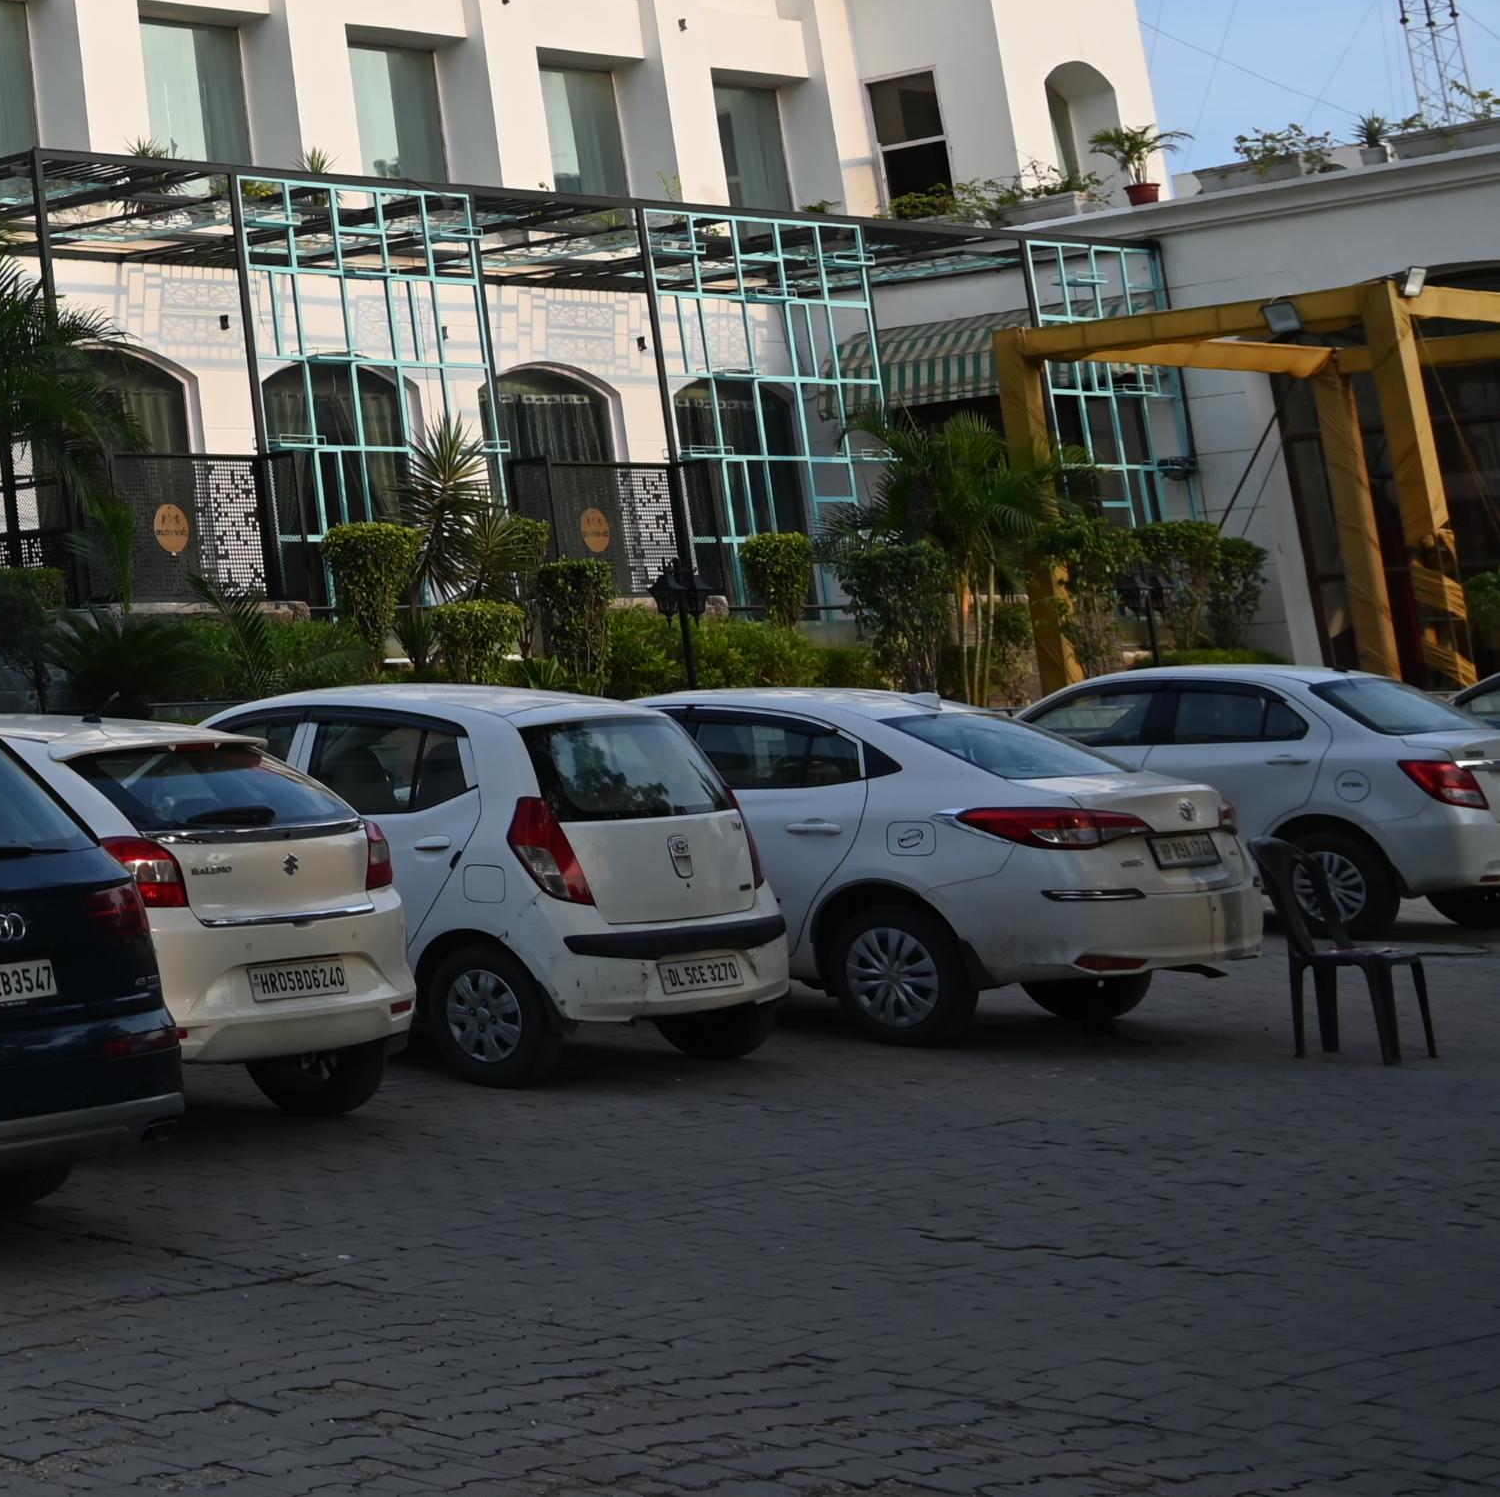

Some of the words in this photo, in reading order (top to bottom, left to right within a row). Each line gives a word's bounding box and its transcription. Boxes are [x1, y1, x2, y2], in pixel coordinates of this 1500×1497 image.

[191, 865, 232, 876] BALENO
[668, 968, 685, 986] DL
[684, 964, 708, 984] 5CE
[707, 962, 737, 982] 3270
